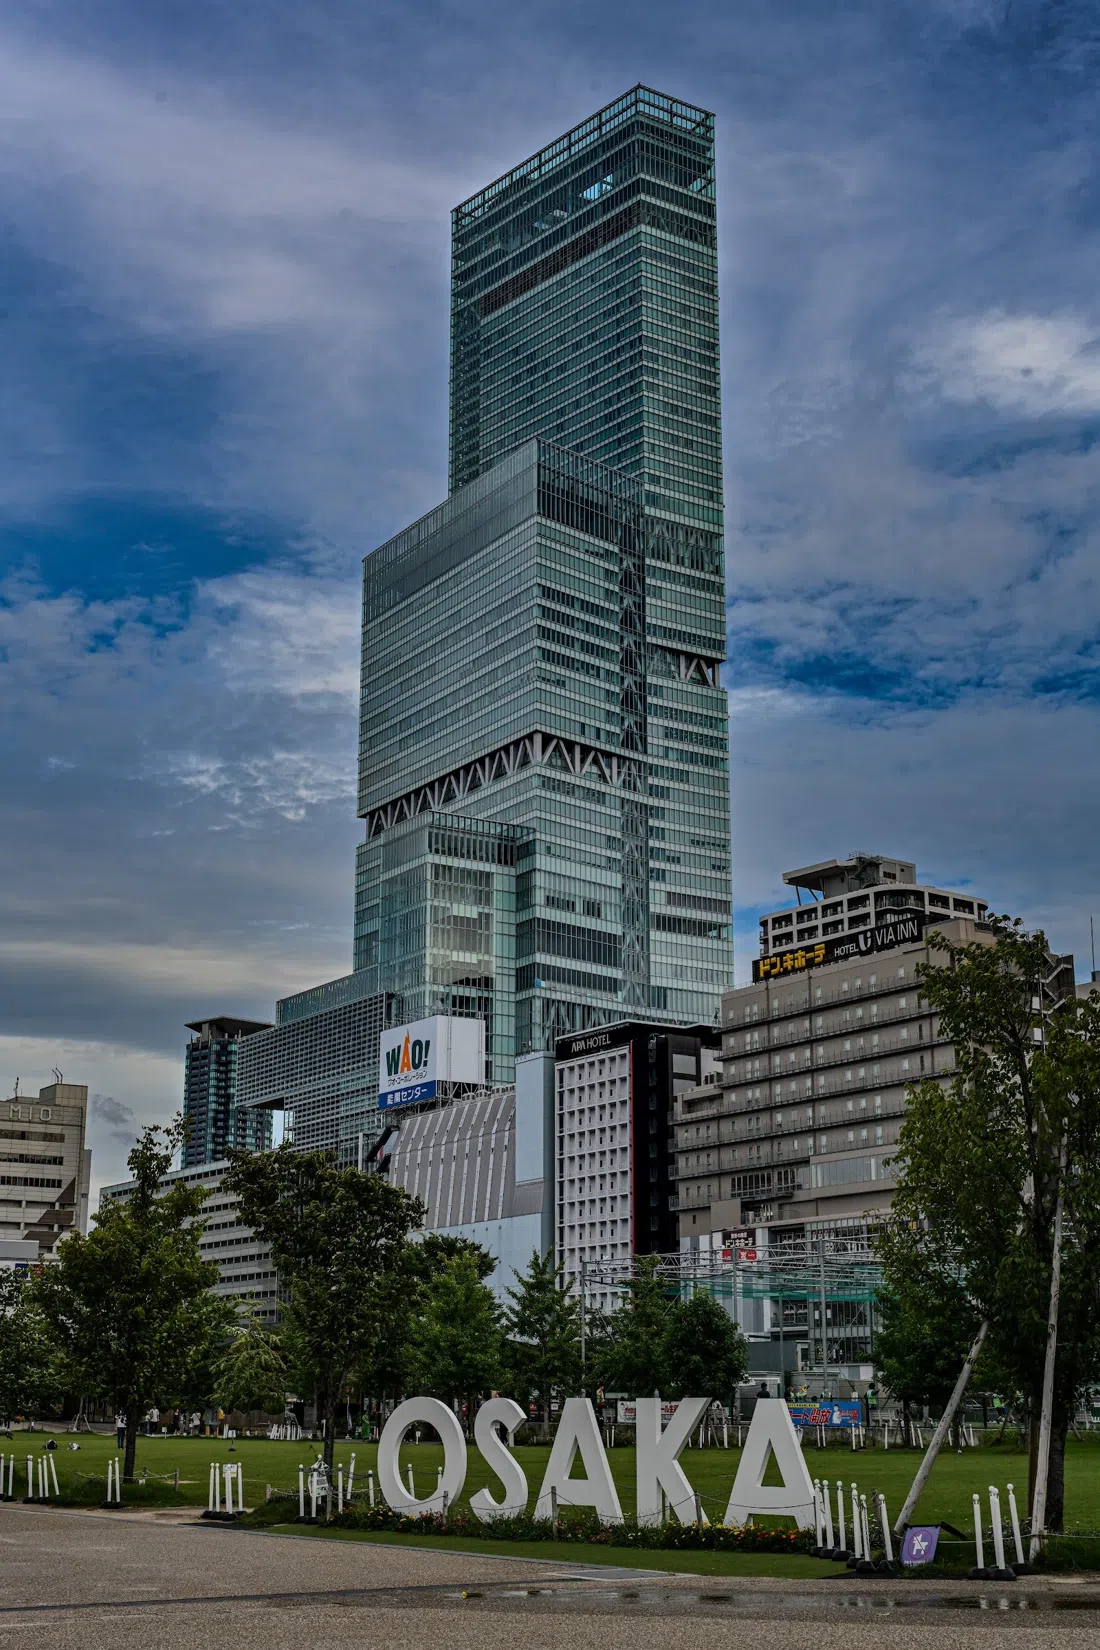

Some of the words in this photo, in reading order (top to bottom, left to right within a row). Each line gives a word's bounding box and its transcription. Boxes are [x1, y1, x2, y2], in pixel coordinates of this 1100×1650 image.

[834, 943, 859, 957] HOTEL
[875, 928, 896, 946] VIA
[897, 919, 918, 941] INN
[385, 1028, 431, 1077] WAO!
[571, 1040, 586, 1053] APA
[586, 1033, 612, 1049] HOTEL
[9, 1105, 52, 1121] MIO
[378, 1396, 825, 1527] OSAKA
